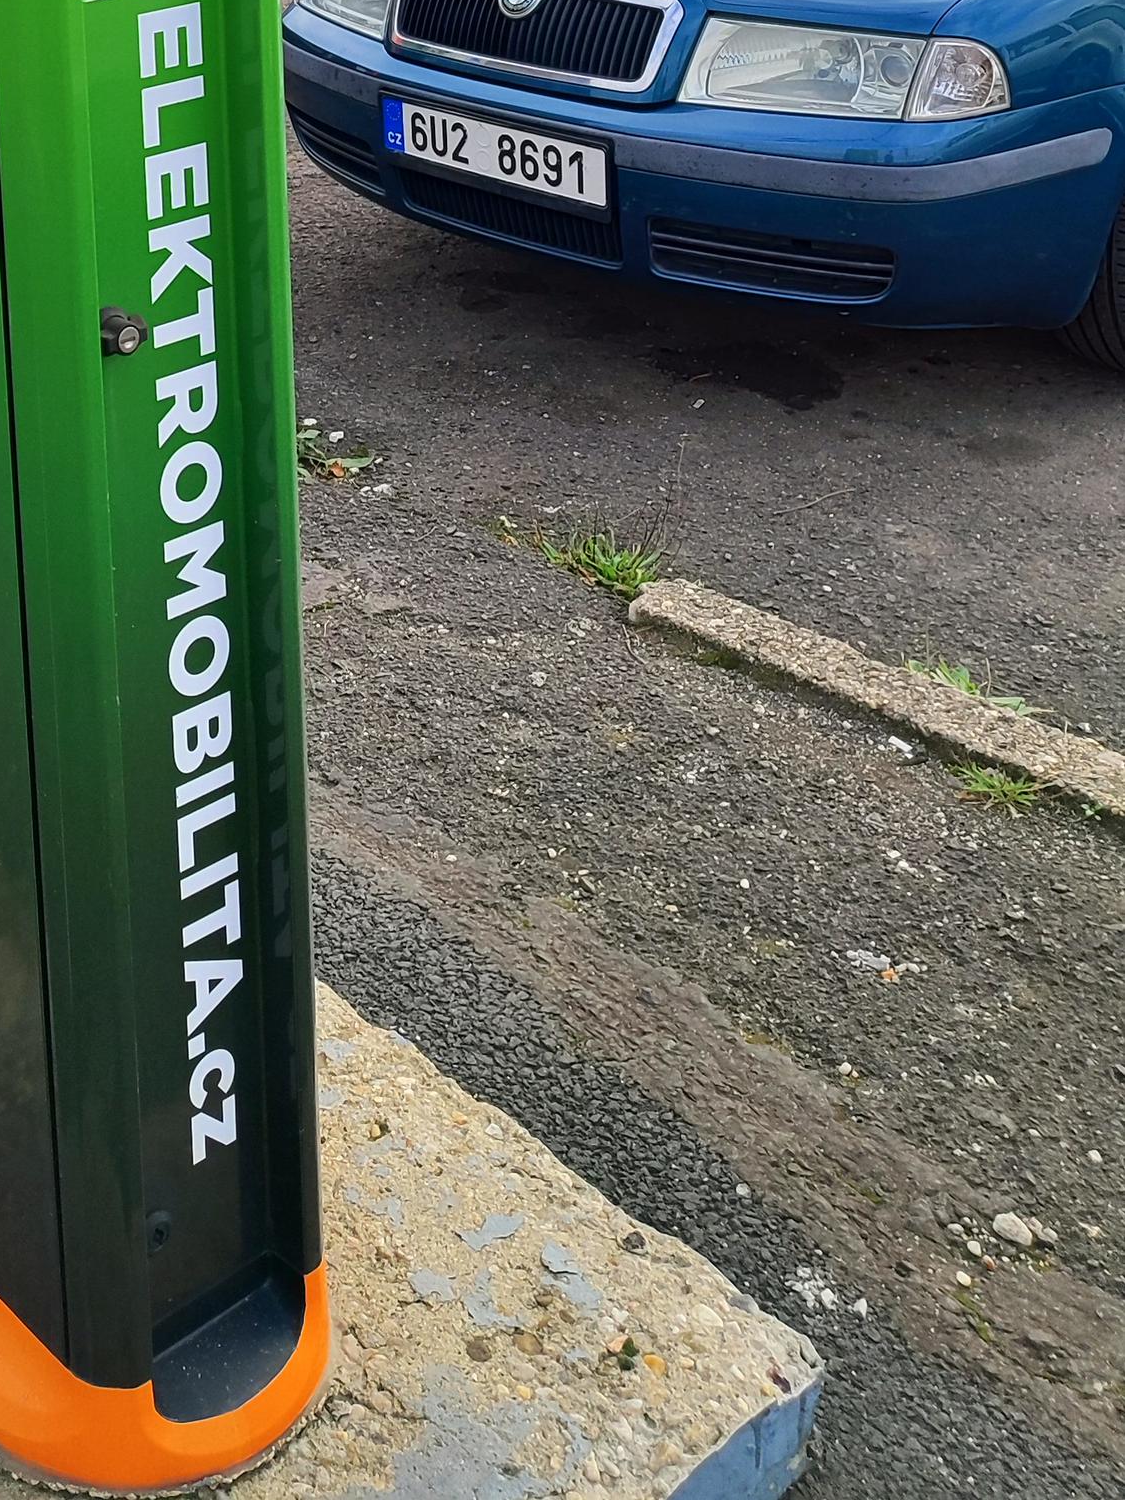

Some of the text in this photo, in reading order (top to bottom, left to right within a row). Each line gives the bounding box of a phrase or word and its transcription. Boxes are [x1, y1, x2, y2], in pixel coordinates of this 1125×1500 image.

[387, 131, 402, 145] CZ
[411, 112, 584, 194] 6U2 8691
